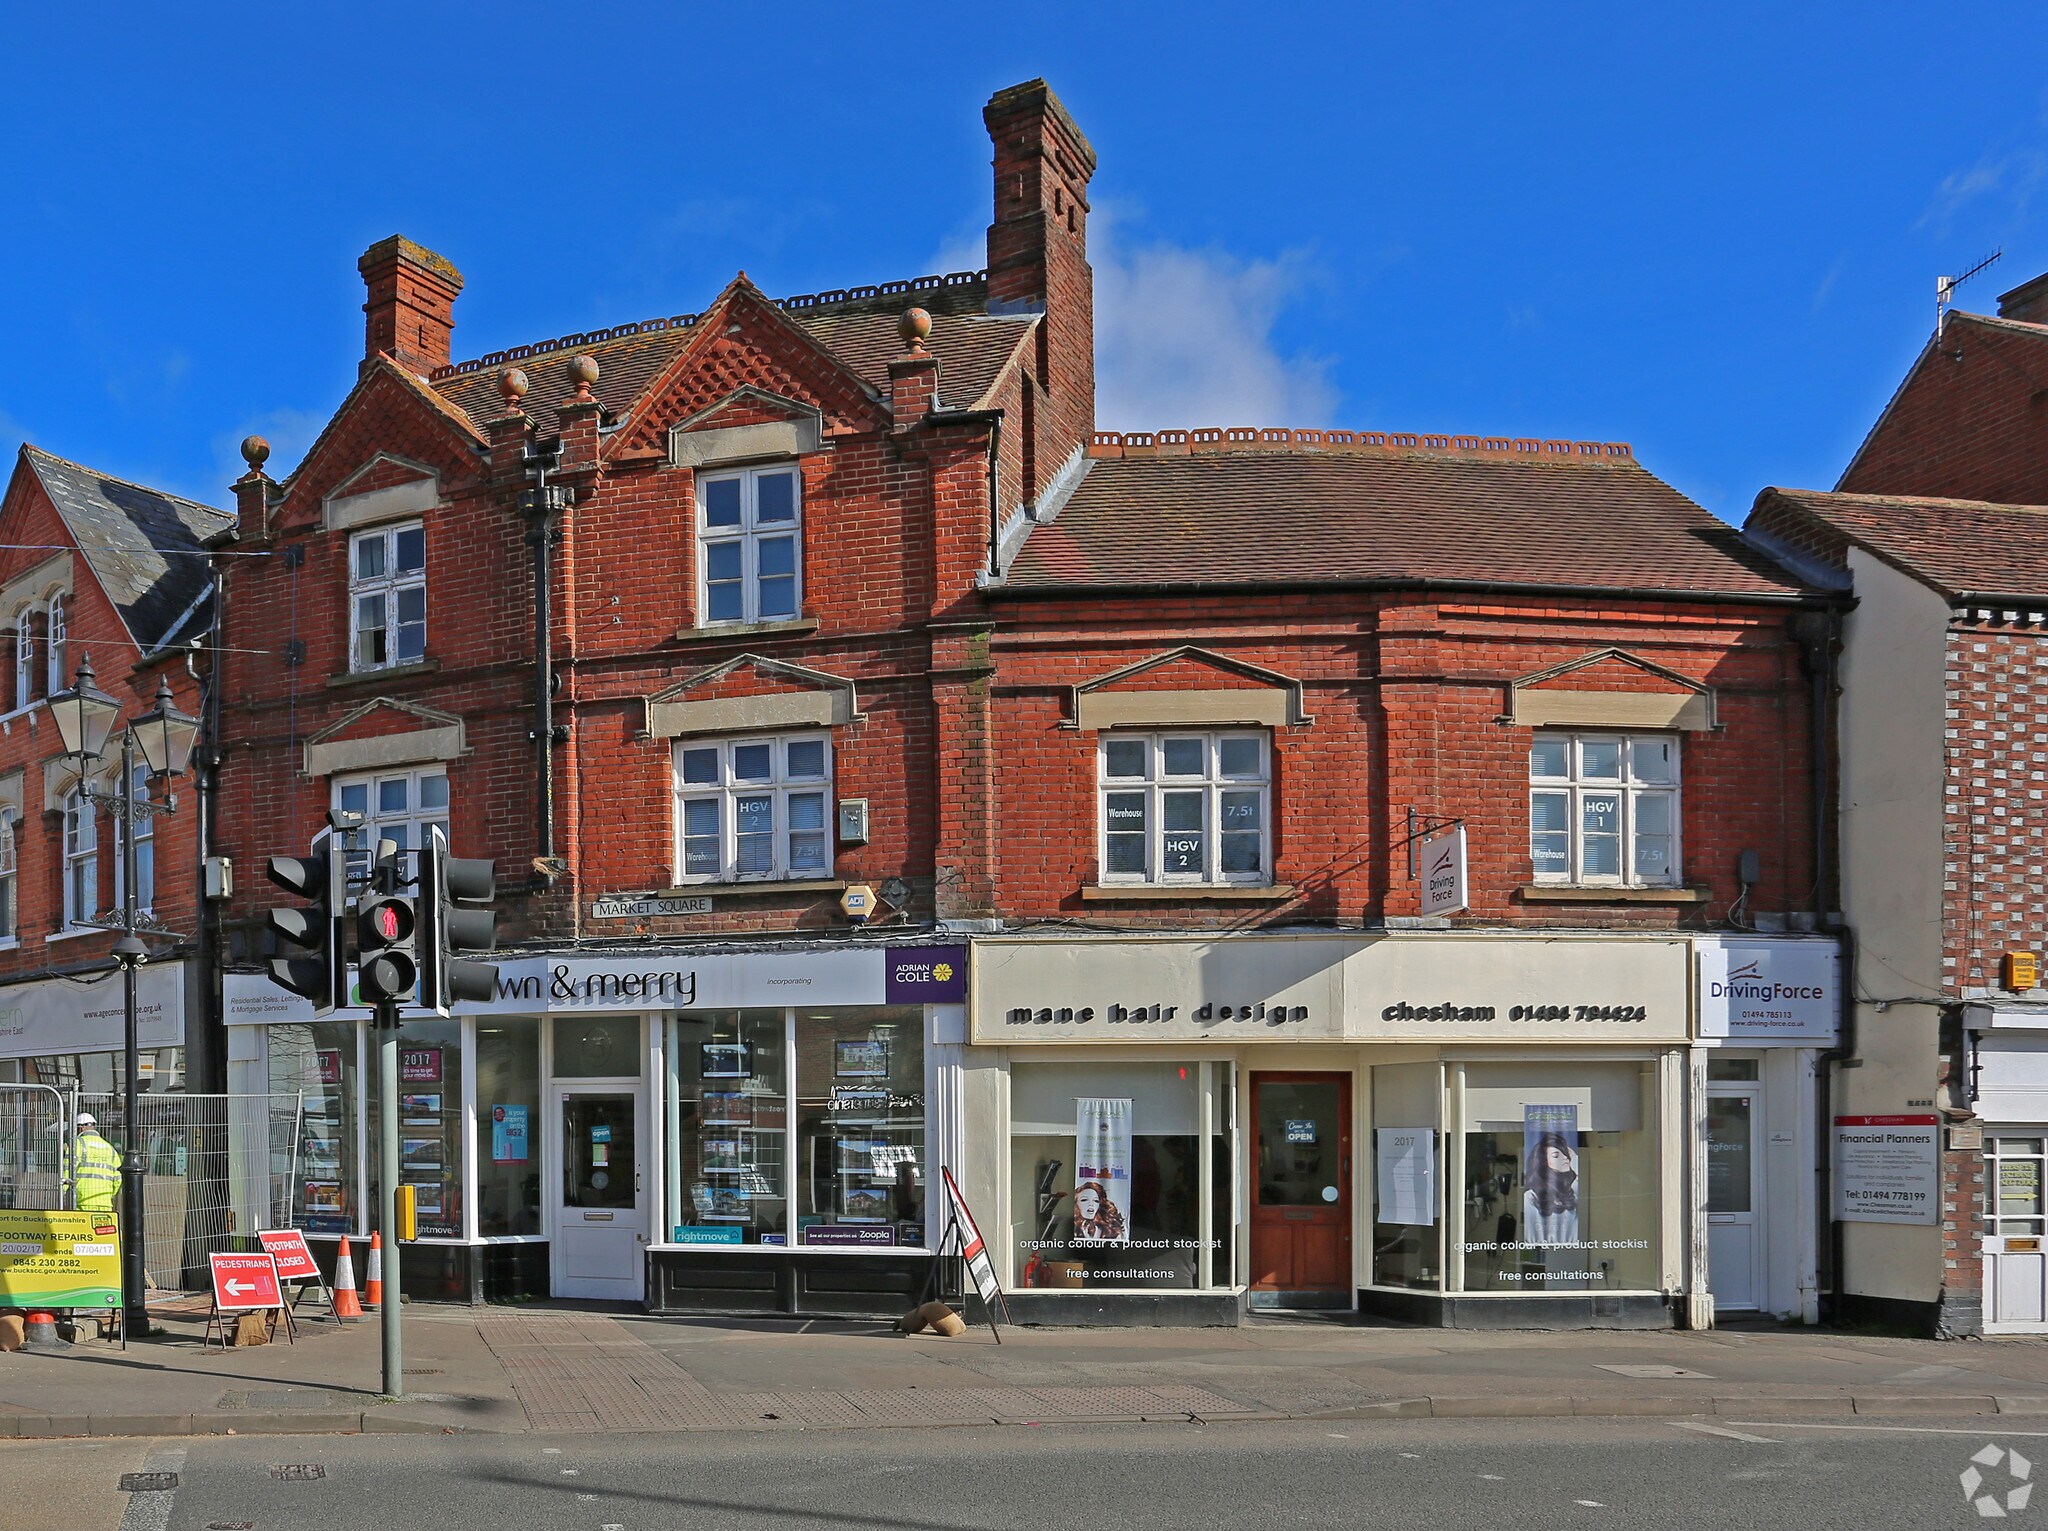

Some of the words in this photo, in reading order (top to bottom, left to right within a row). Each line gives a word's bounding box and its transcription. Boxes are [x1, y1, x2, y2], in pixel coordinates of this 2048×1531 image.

[740, 802, 768, 812] HGV
[1228, 806, 1253, 817] 7.5t
[1586, 802, 1614, 812] HGV
[1109, 808, 1143, 818] Warehouse
[751, 816, 758, 826] 2
[1598, 817, 1603, 826] 1
[1168, 841, 1198, 851] HGV
[687, 852, 718, 861] Warehouse
[1534, 849, 1565, 859] Warehouse
[1640, 851, 1663, 861] 7.5t
[1180, 856, 1187, 866] 2
[1430, 876, 1454, 890] Driving
[848, 896, 864, 905] ADT
[1432, 890, 1452, 903] Force
[600, 902, 652, 915] MARKET
[658, 899, 706, 913] SQUARE
[896, 964, 930, 972] ADRIAN
[767, 978, 812, 986] incorporating
[896, 972, 930, 983] COLE
[551, 965, 576, 998] &
[586, 972, 696, 1005] merry
[1711, 982, 1823, 1002] DrivingForce
[231, 997, 261, 1005] Residential
[263, 996, 280, 1004] Sales,
[236, 1006, 262, 1014] Mortgage
[1011, 1005, 1095, 1023] mane
[1111, 1002, 1178, 1023] hair
[1197, 1002, 1309, 1025] design
[1381, 1001, 1496, 1022] chesham
[1742, 1011, 1764, 1019] 01494
[1766, 1011, 1792, 1019] 785113
[1730, 1020, 1805, 1028] www.driving-force.co.uk
[13, 1027, 24, 1035] East
[405, 1054, 430, 1065] 2017
[1395, 1137, 1415, 1146] 2017
[1840, 1134, 1884, 1144] Financial
[1887, 1134, 1931, 1144] Planners
[1708, 1143, 1744, 1152] ngForce
[1846, 1190, 1860, 1199] Tel:
[1863, 1191, 1890, 1200] 01494
[1892, 1192, 1926, 1201] 778199
[24, 1216, 86, 1224] Buckinghamshire
[417, 1226, 453, 1235] ghtmove
[860, 1230, 890, 1240] Zoopla
[51, 1233, 94, 1242] REPAIRS
[677, 1232, 730, 1242] rightmove
[3, 1245, 41, 1253] 20/02/17
[75, 1246, 113, 1254] 07/04/17
[265, 1240, 303, 1251] FOOTPATH
[1020, 1239, 1064, 1250] organic
[1069, 1239, 1106, 1249] colour
[1110, 1240, 1119, 1249] &
[1122, 1239, 1170, 1250] product
[1501, 1240, 1537, 1250] colour
[1541, 1240, 1550, 1250] &
[1553, 1240, 1599, 1251] product
[1602, 1239, 1649, 1249] stockist
[13, 1259, 36, 1267] 0845
[39, 1259, 56, 1267] 230
[58, 1259, 81, 1267] 2882
[216, 1260, 271, 1269] PEDESTRIANS
[276, 1256, 305, 1267] CLOSED
[1066, 1268, 1090, 1278] free
[1093, 1268, 1175, 1278] consultations
[1499, 1271, 1521, 1281] free
[1525, 1270, 1604, 1281] consultations
